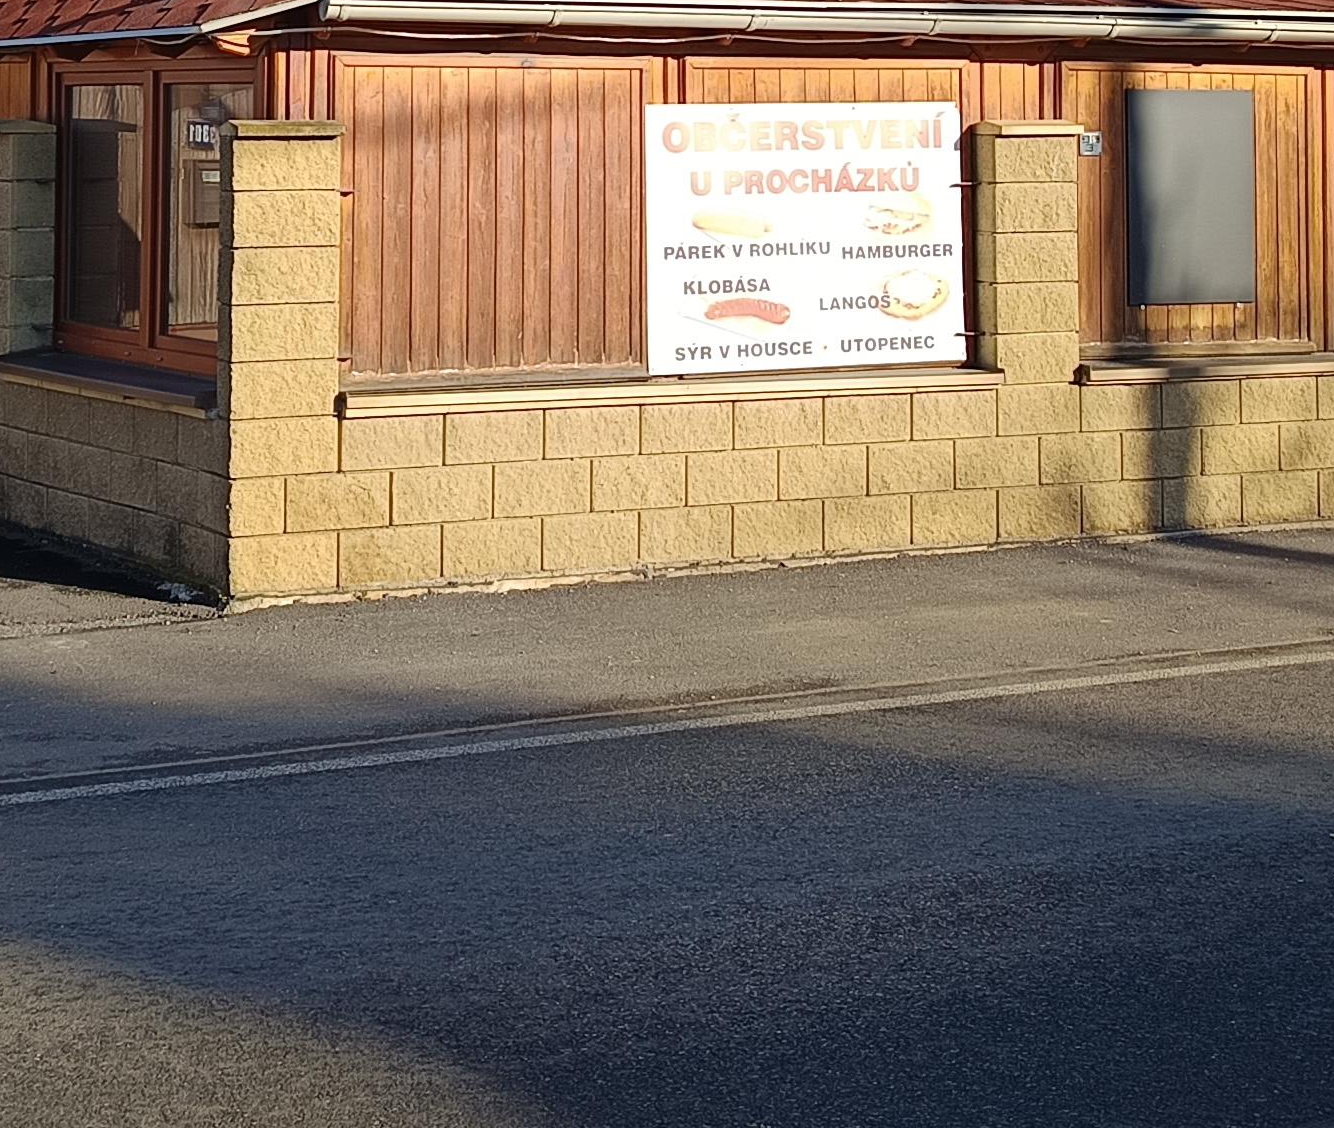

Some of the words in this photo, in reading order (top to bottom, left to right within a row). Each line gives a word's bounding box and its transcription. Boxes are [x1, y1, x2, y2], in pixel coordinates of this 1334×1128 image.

[662, 111, 945, 153] OBČERSTVENÍ
[690, 171, 712, 196] U
[724, 161, 920, 195] PROCHÁZKŮ
[663, 241, 726, 260] PÁREK
[732, 244, 743, 258] V
[749, 238, 831, 257] ROHLÍKU
[841, 243, 954, 260] HAMBURGER
[683, 276, 772, 295] KLOBÁSA
[819, 290, 892, 311] LANGOŠ
[675, 342, 712, 361] SÝR
[719, 345, 731, 359] V
[736, 341, 814, 358] HOUSCE
[840, 335, 936, 353] UTOPENEC
